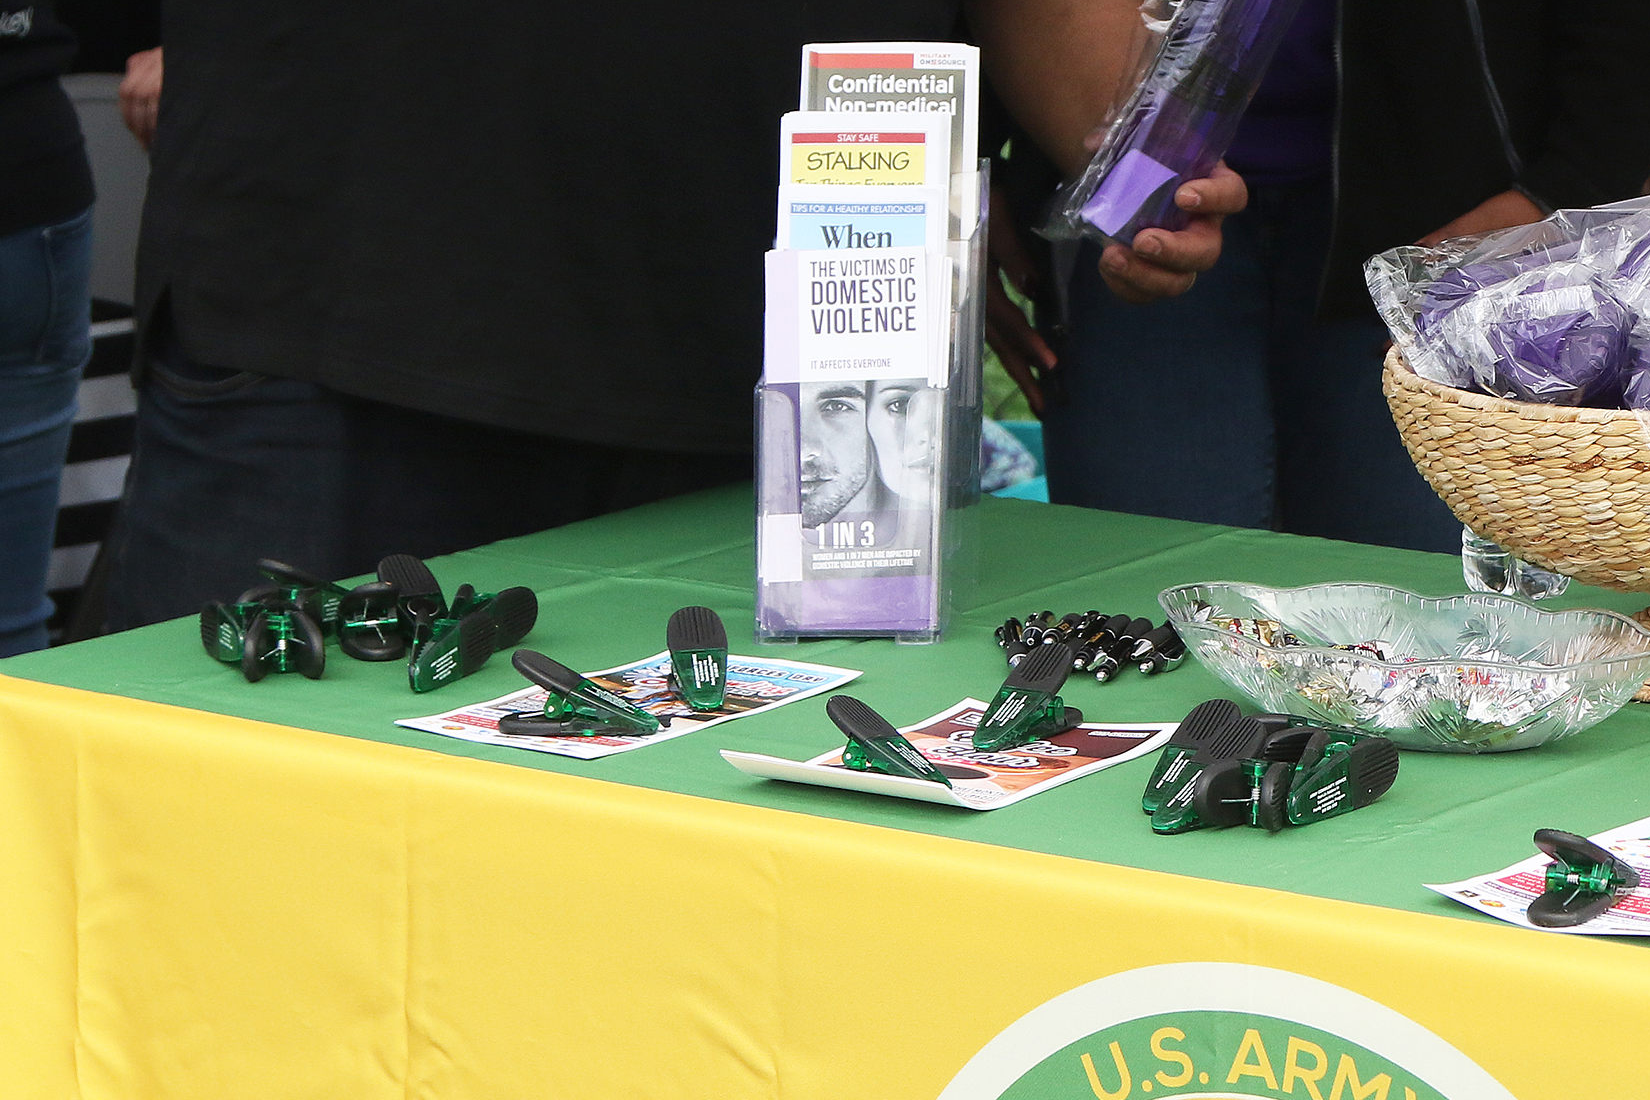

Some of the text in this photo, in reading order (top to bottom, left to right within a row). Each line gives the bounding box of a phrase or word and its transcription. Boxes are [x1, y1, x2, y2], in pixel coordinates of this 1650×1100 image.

[828, 74, 955, 94] Confidential
[825, 97, 957, 115] Non-medical
[837, 133, 879, 142] STAY SAFE
[807, 151, 910, 171] STALKING
[792, 204, 924, 214] TIPS FOR A HEALTHY RELATIONSHIP
[819, 222, 892, 248] When
[810, 257, 916, 278] THE VICTIMS OF
[811, 277, 916, 305] DOMESTIC
[811, 306, 917, 334] VIOLENCE
[811, 358, 892, 370] IT AFFECTS EVERYONE
[816, 520, 875, 549] 1 IN 3
[1080, 1026, 1417, 1100] U.S. ARM
